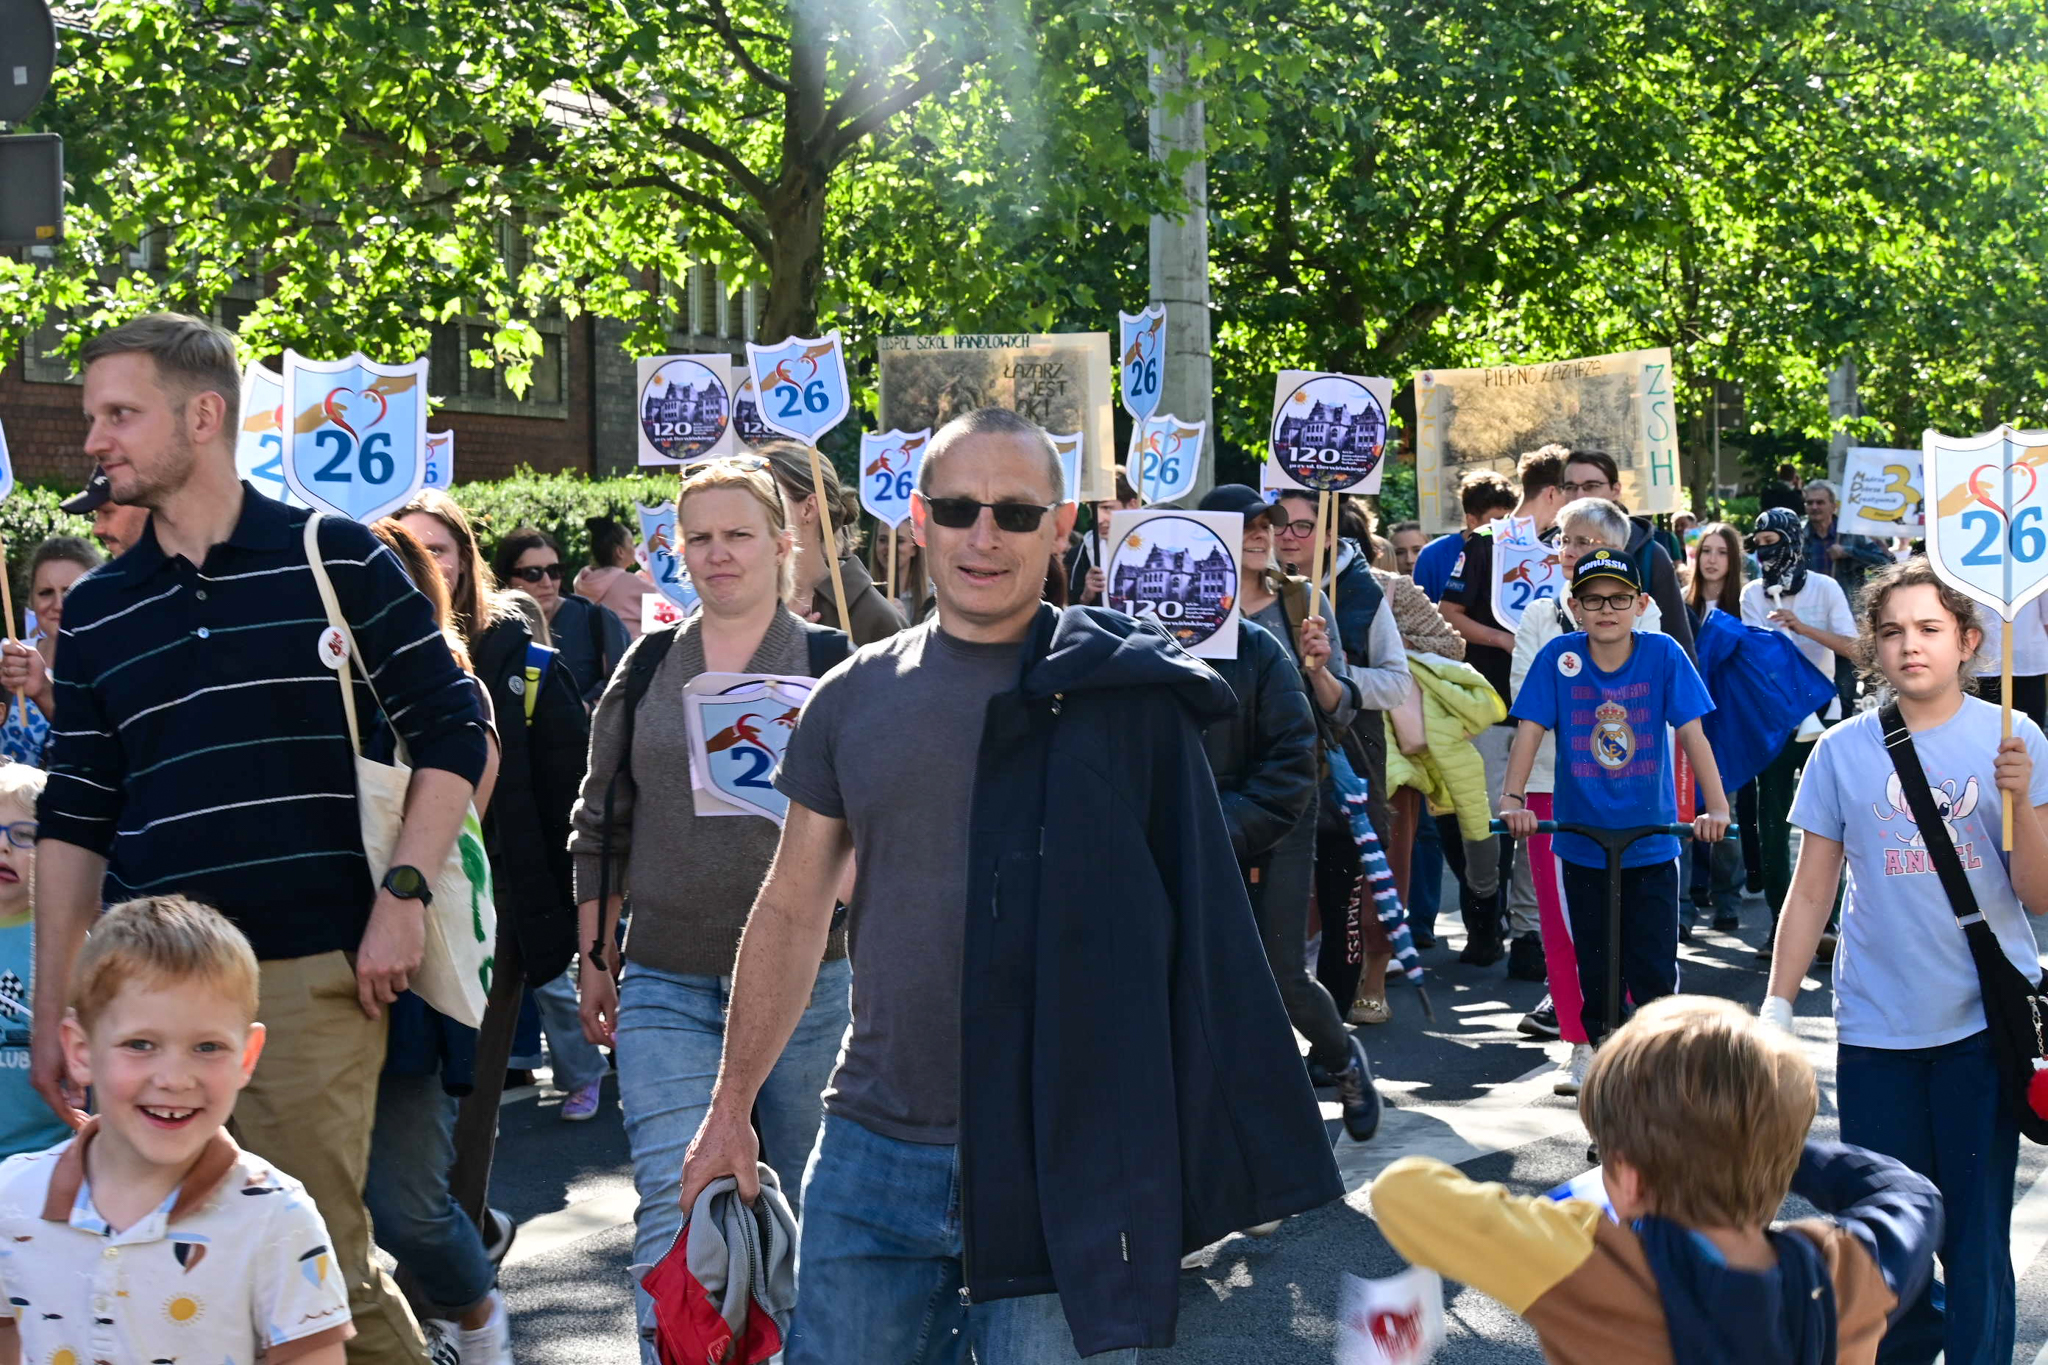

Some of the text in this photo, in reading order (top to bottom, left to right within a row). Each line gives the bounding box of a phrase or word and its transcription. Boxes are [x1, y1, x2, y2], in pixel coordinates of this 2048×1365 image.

[954, 334, 1030, 349] HANDLOWYCH
[1028, 380, 1067, 397] JEST
[1131, 357, 1157, 397] 26
[774, 379, 830, 419] 26
[653, 421, 692, 437] 120
[1645, 363, 1675, 487] ZSH
[251, 433, 284, 484] 2
[313, 429, 395, 485] 26
[1143, 452, 1180, 485] 26
[1288, 446, 1340, 464] 120
[426, 462, 438, 484] 6
[874, 471, 914, 502] 26
[1960, 505, 2047, 567] 26
[657, 550, 679, 584] 2
[1578, 558, 1628, 575] BORUSSIA
[1122, 600, 1184, 619] 120
[730, 746, 775, 790] 2
[1884, 841, 1983, 877] ANEL
